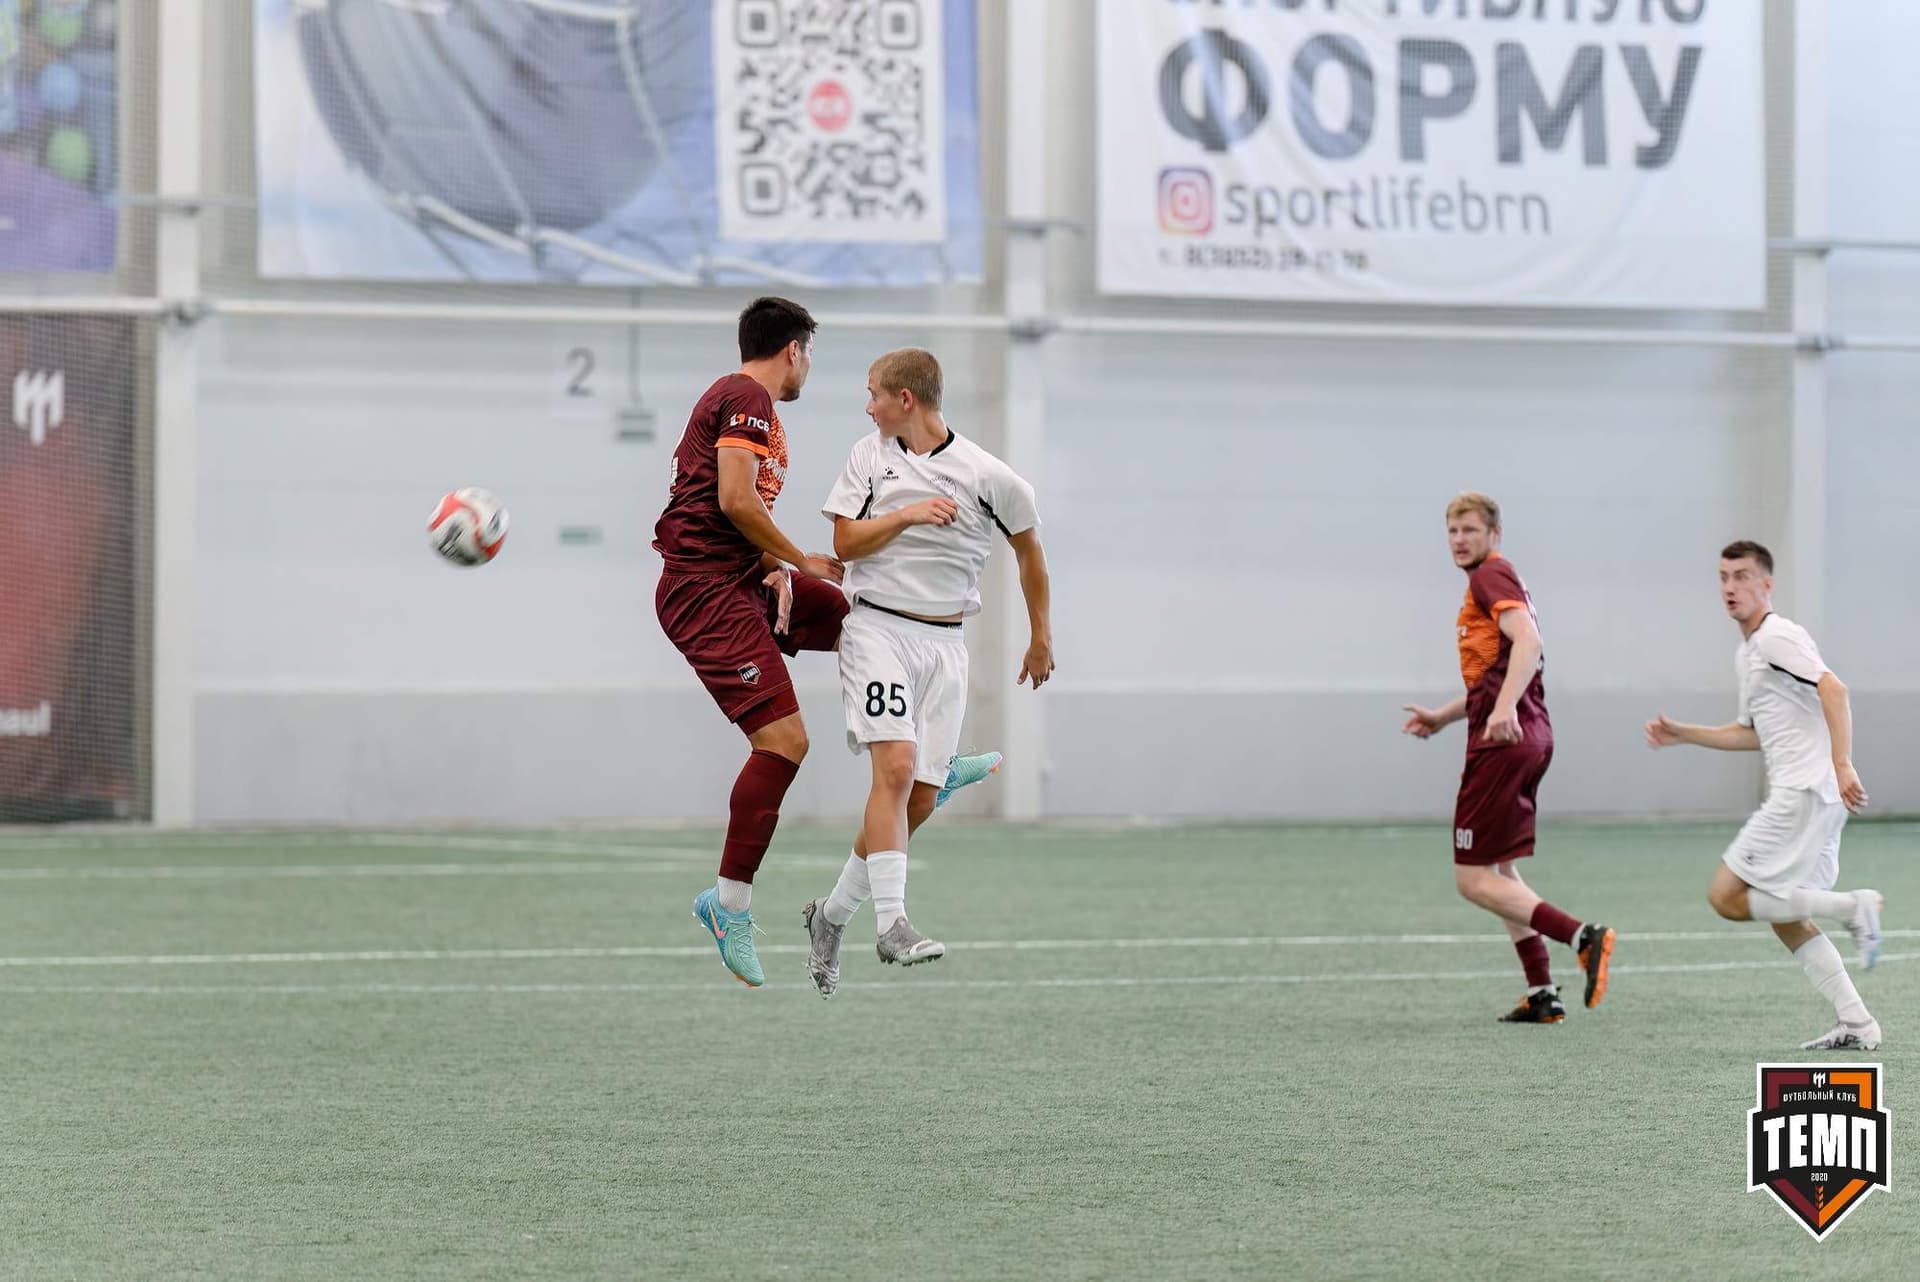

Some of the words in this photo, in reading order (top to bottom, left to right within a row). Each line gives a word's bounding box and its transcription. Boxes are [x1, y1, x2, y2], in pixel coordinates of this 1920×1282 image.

[1157, 27, 1703, 171] ФОРМУ
[1223, 175, 1552, 237] sportlifebrn
[565, 346, 597, 398] 2
[0, 700, 52, 737] aul
[865, 681, 907, 717] 85
[1455, 827, 1474, 850] 90
